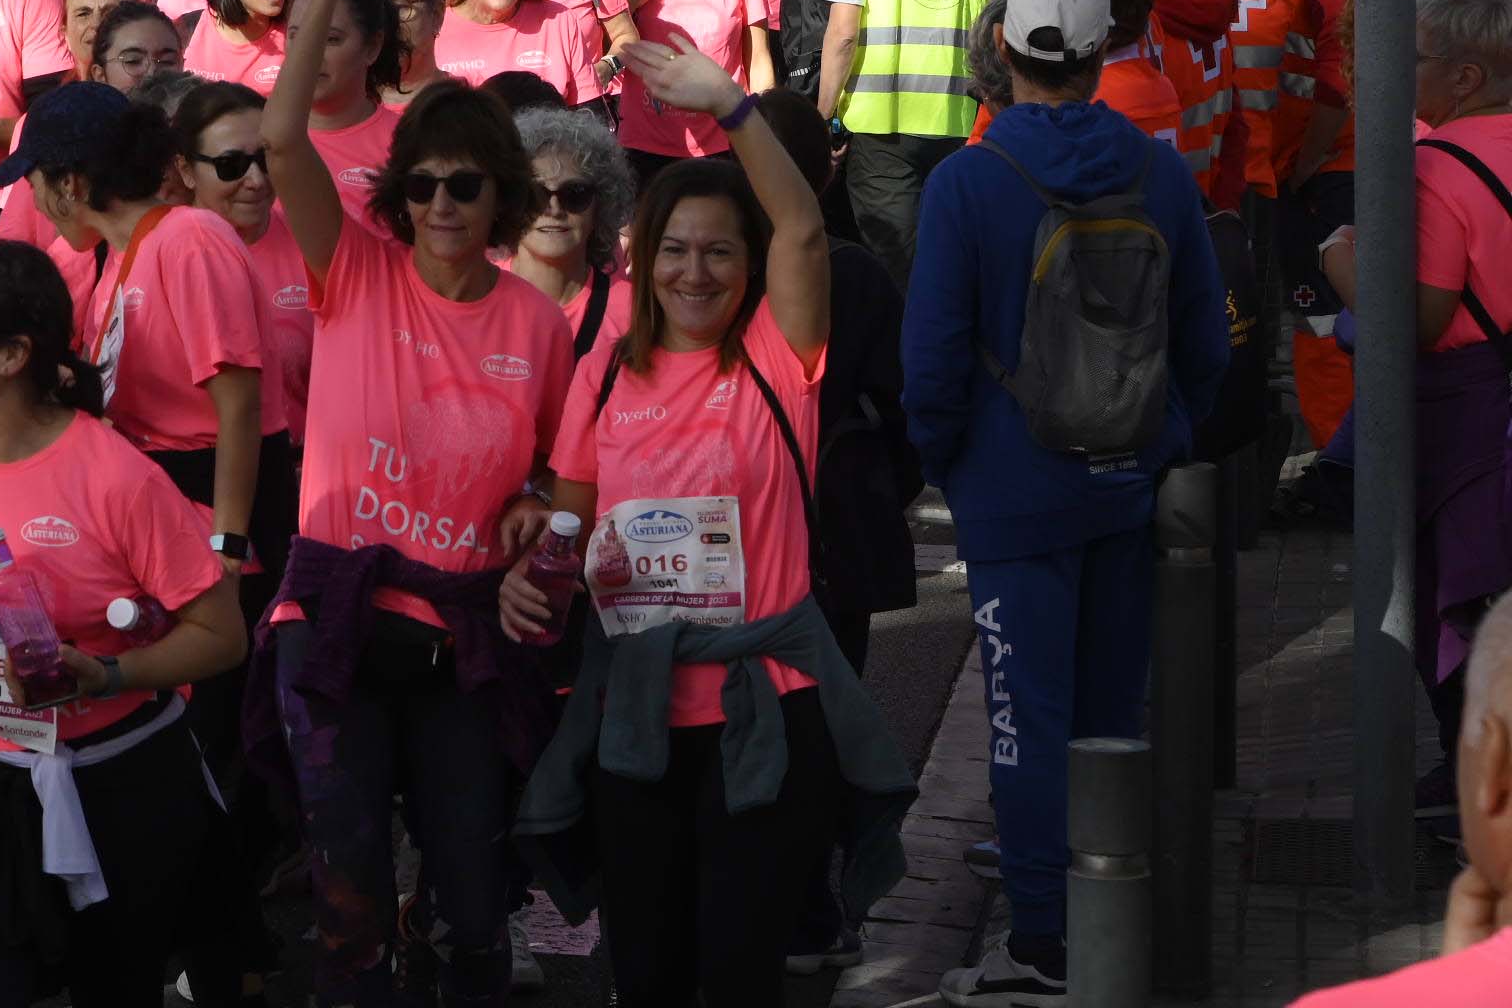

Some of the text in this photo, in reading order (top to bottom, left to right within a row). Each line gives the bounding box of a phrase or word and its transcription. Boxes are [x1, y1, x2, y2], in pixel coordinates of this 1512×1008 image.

[367, 437, 408, 483] TU
[1089, 463, 1117, 474] SINCE
[355, 486, 489, 553] DORSAL
[698, 515, 728, 524] SUMA
[25, 525, 76, 541] ASTURIANA
[630, 523, 689, 537] ASTURIANA
[635, 554, 688, 575] 016
[651, 595, 662, 603] DE
[663, 595, 674, 603] LA
[676, 595, 705, 606] MUJER
[708, 597, 728, 605] 2023
[974, 596, 1019, 767] BARÇA
[5, 724, 49, 739] Santander
